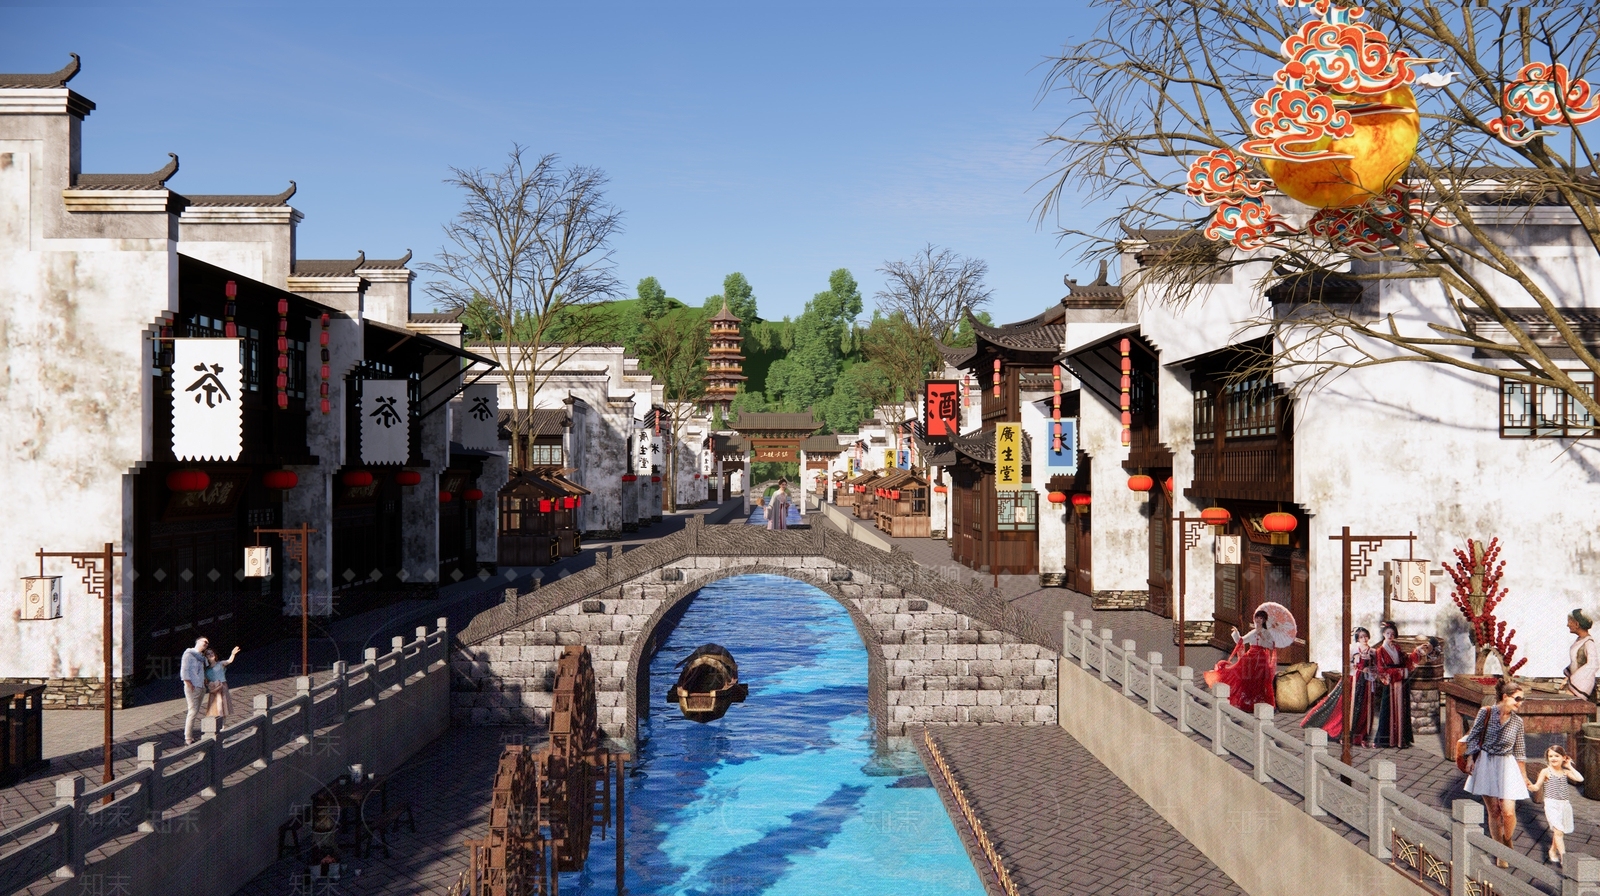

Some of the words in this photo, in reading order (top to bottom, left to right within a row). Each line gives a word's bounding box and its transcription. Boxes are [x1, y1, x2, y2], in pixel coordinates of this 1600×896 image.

[186, 362, 231, 408] 茶
[369, 396, 402, 428] 茶
[468, 397, 493, 421] 茶
[929, 391, 956, 421] 酒
[1000, 426, 1015, 481] 廣生堂
